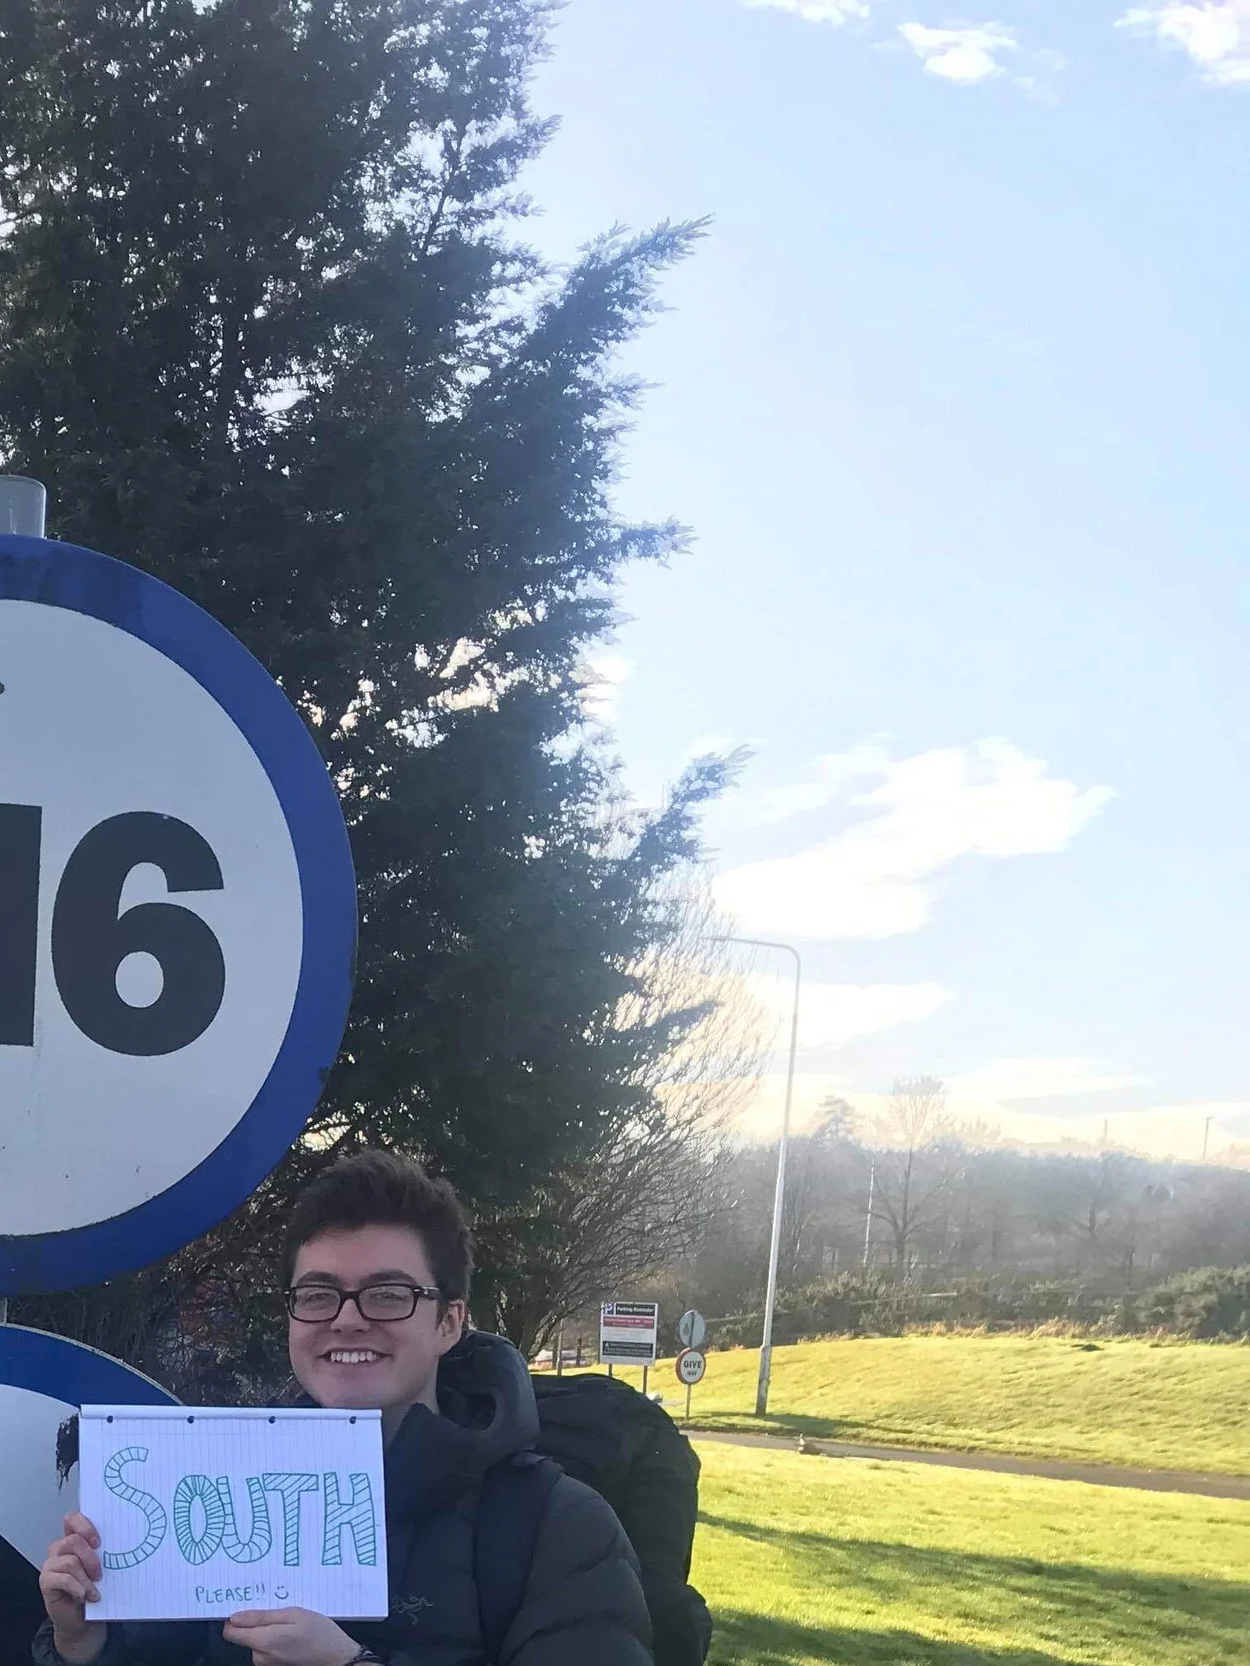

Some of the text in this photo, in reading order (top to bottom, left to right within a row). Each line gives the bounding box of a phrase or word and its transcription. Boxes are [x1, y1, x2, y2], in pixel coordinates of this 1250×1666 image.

[683, 1360, 702, 1369] GIVE
[103, 1446, 377, 1570] SOUTH
[195, 1583, 266, 1603] PLEASE!!
